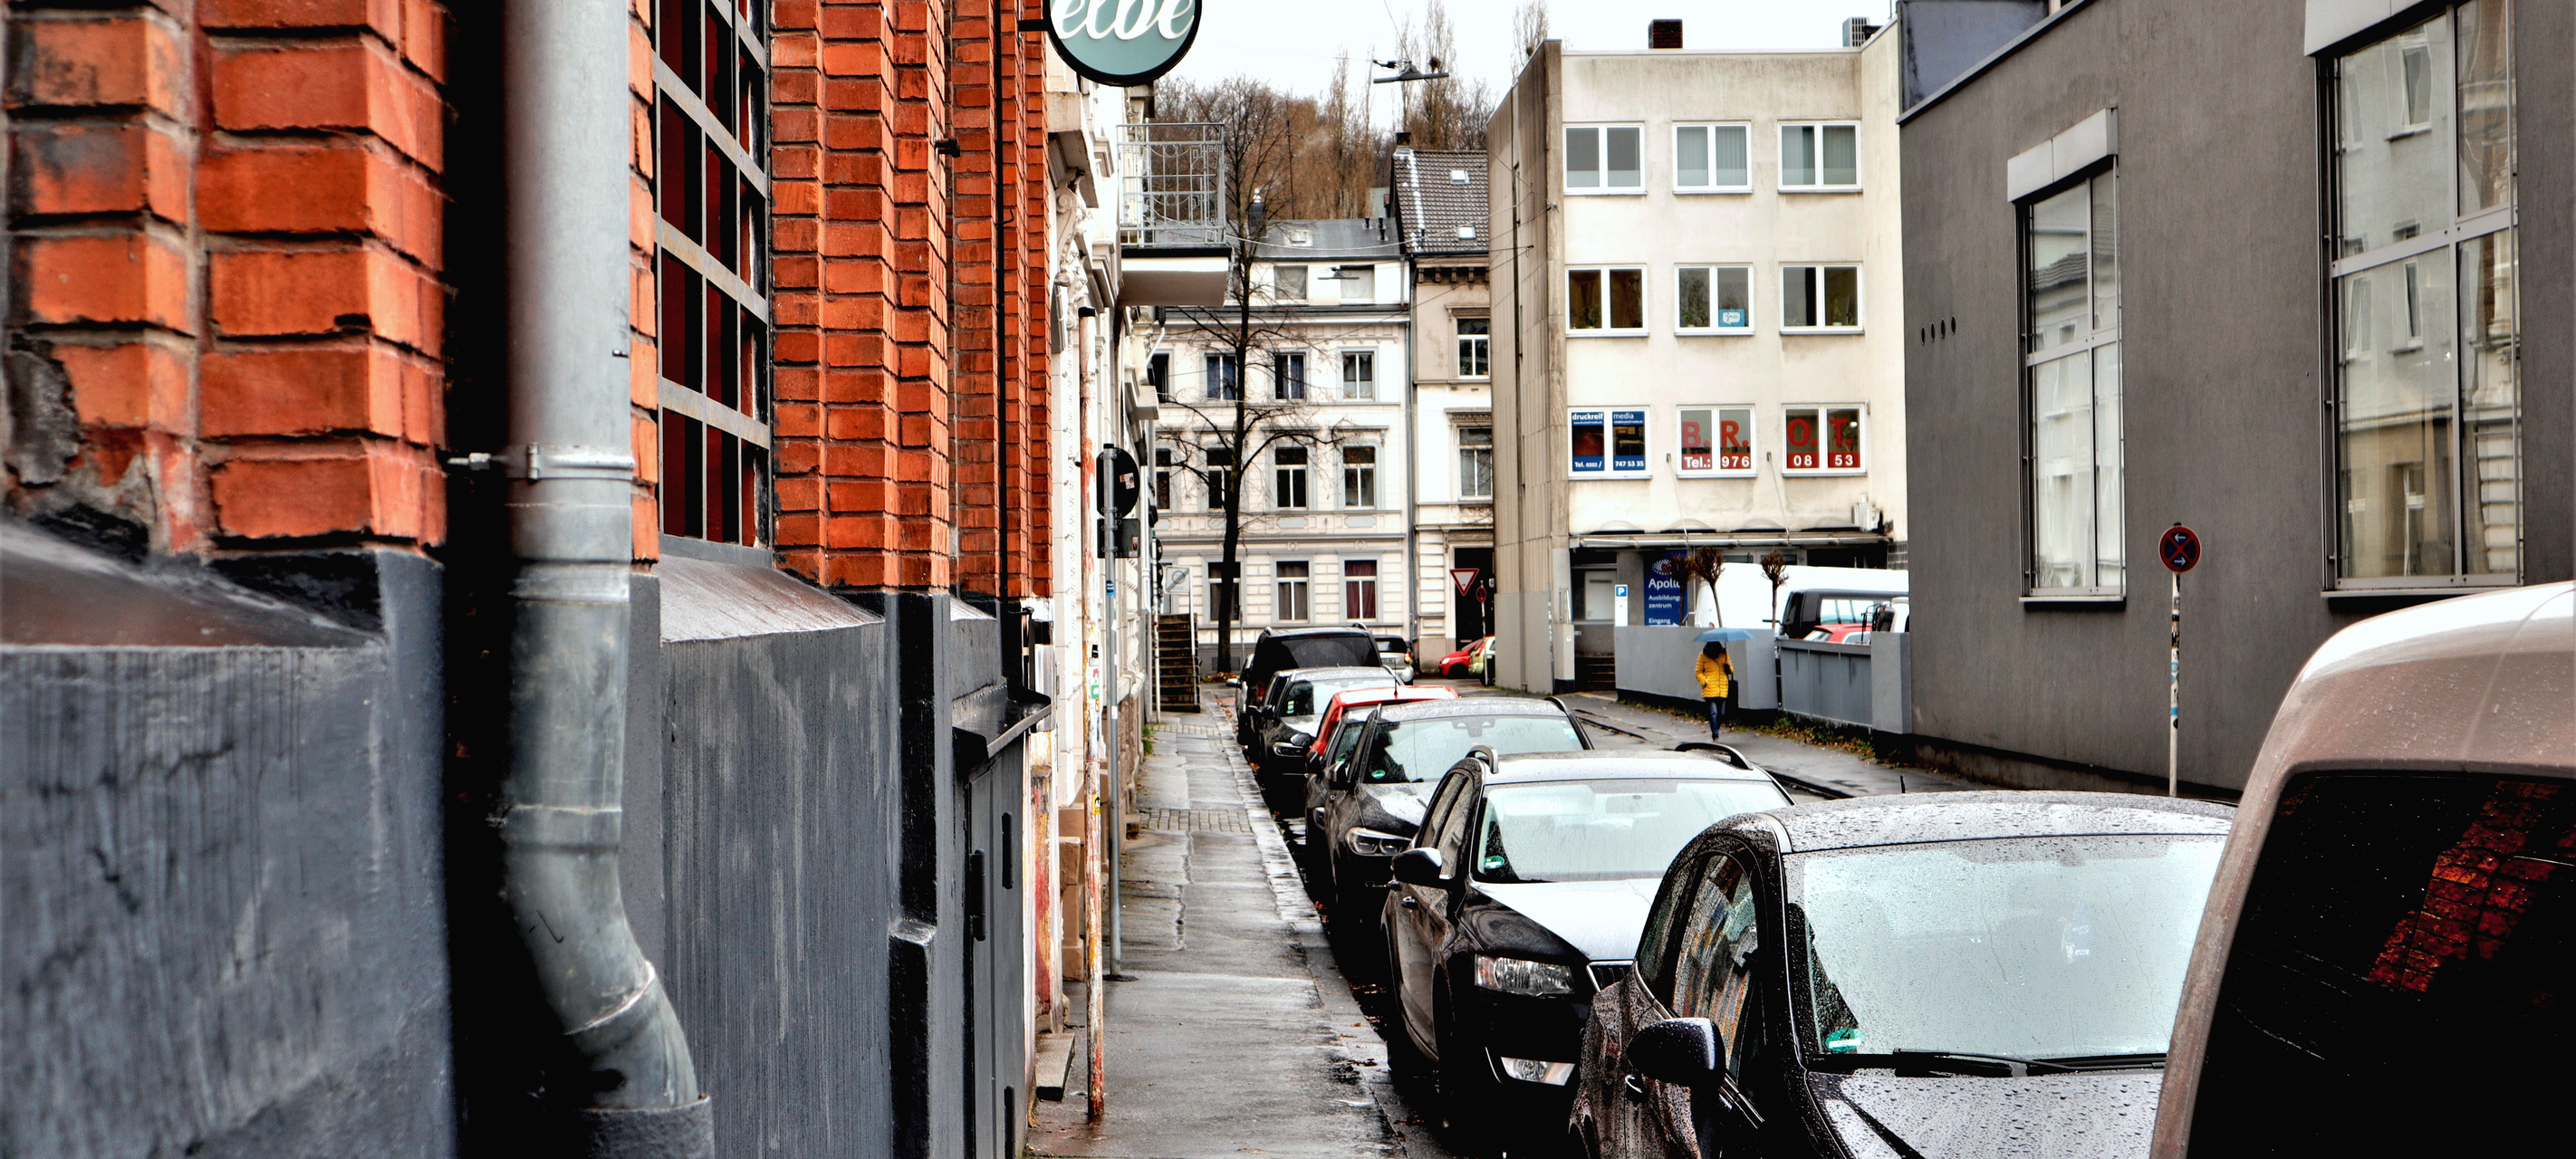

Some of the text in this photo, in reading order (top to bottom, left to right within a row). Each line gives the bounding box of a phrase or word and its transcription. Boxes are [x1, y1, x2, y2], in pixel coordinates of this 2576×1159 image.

[1682, 418, 1853, 447] B. R. O. T.
[1684, 455, 1853, 468] Tel.: 976 08 53
[1618, 587, 1625, 596] P
